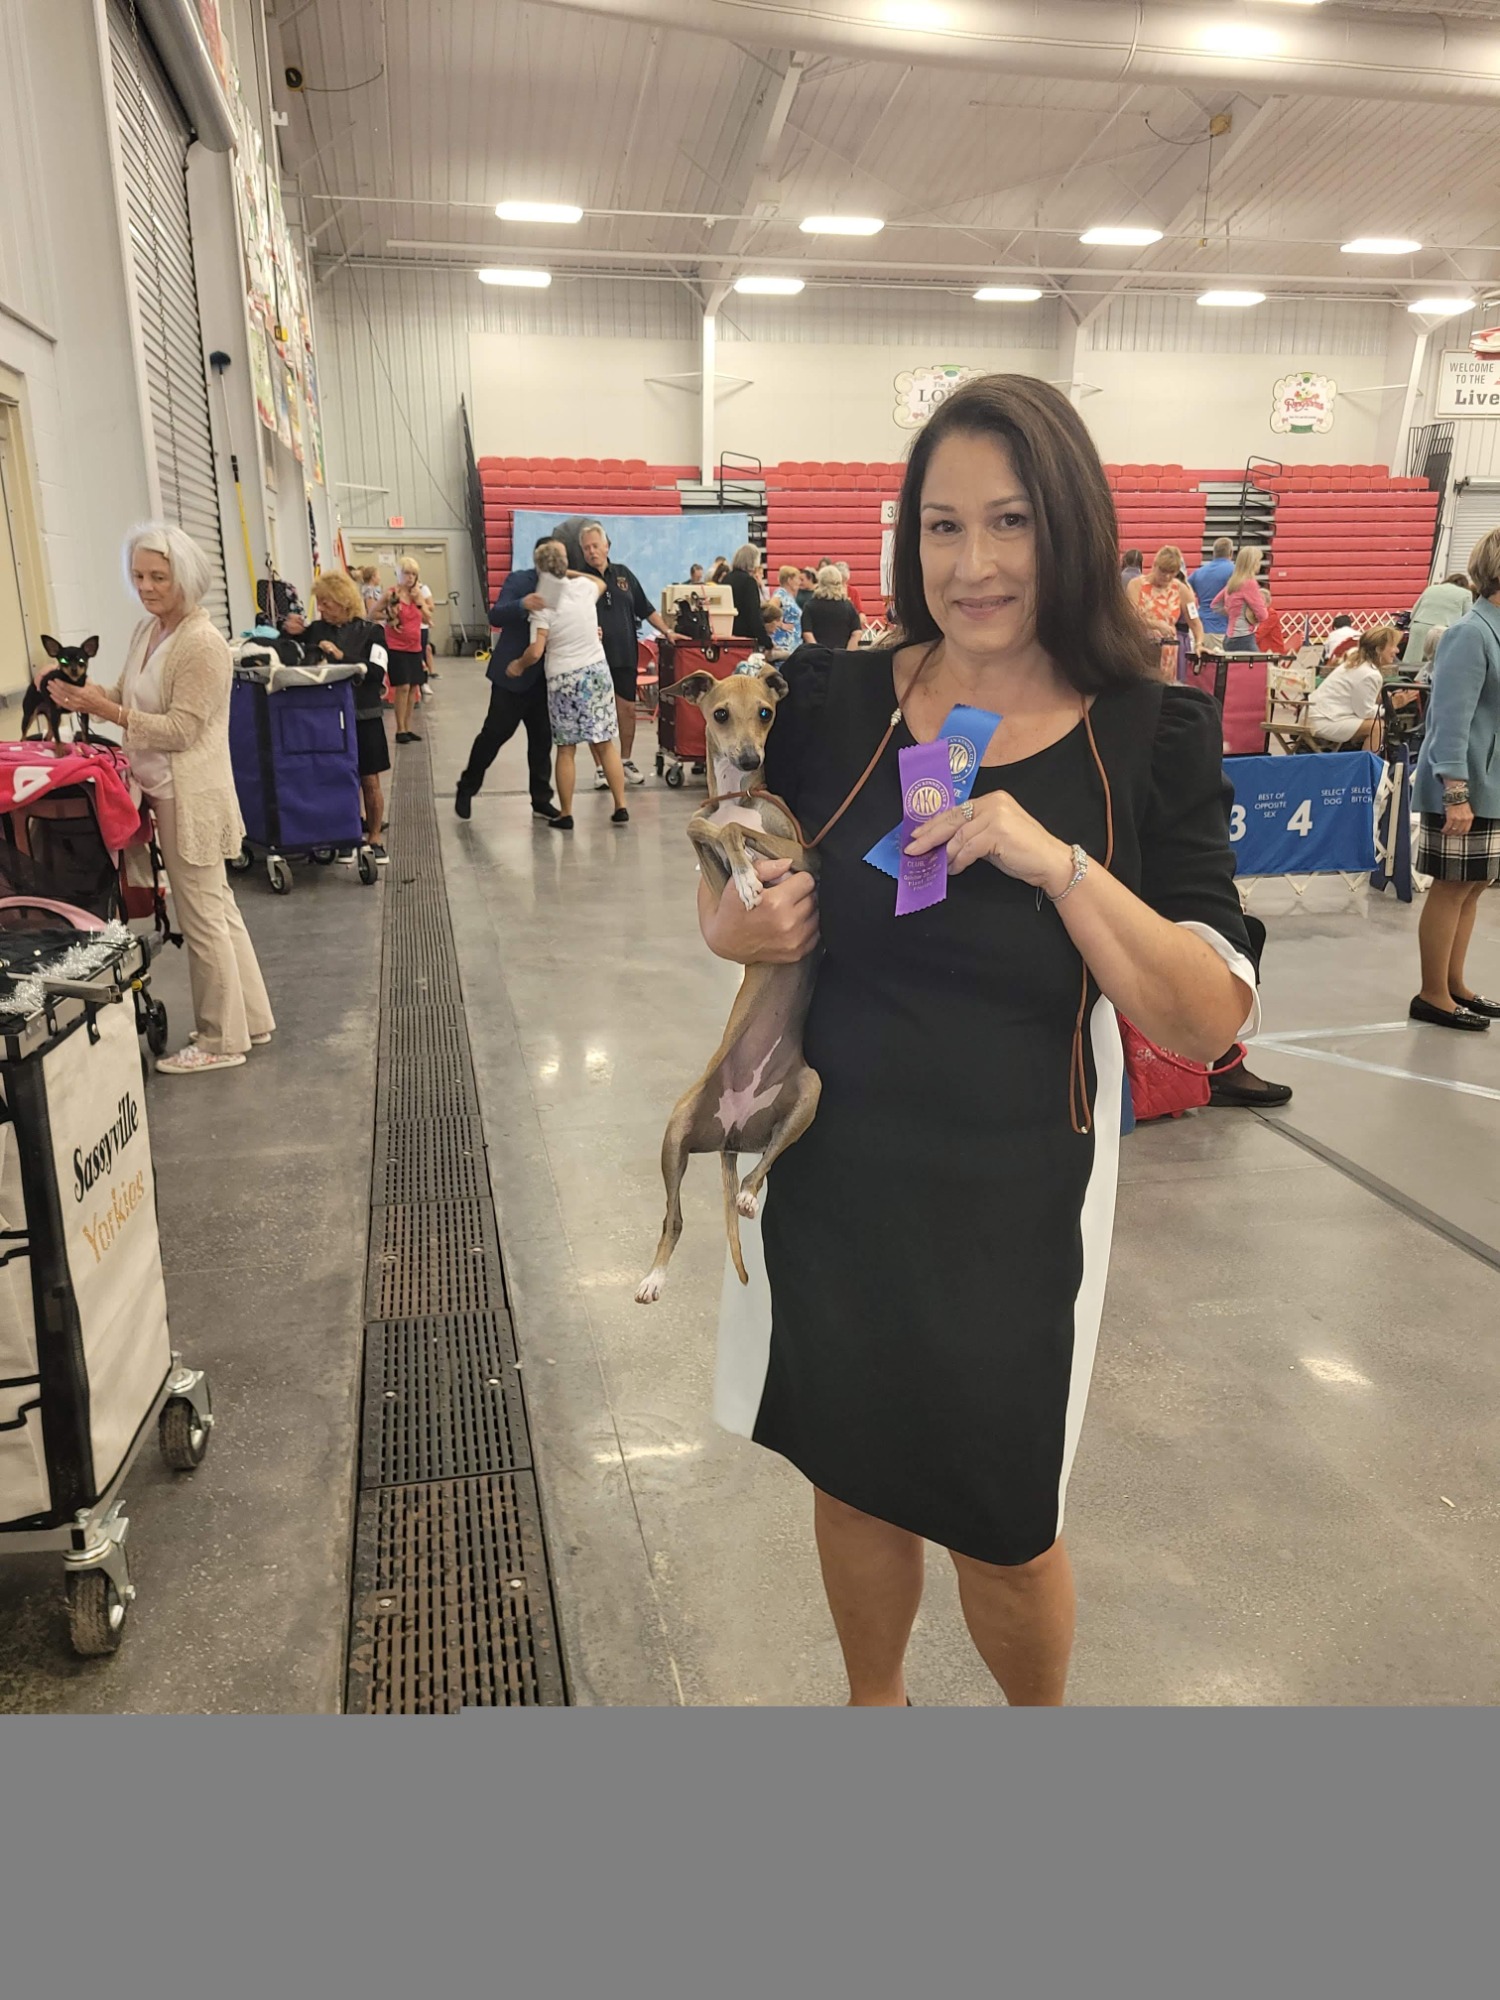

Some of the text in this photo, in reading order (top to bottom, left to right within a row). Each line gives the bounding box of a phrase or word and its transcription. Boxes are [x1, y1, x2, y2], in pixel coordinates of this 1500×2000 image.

[1449, 362, 1495, 373] WELCOME
[1455, 374, 1486, 385] TO THE
[887, 506, 894, 518] 3
[949, 744, 968, 774] KC
[1321, 788, 1346, 797] SELECT
[1351, 786, 1372, 795] SELEC
[913, 786, 942, 816] AKC
[1323, 798, 1342, 806] DOG
[1351, 795, 1373, 804] BITCH
[1254, 801, 1287, 810] OPPOSITE
[1229, 804, 1247, 842] 3
[1286, 799, 1313, 837] 4
[73, 1090, 139, 1204] Sassyville
[82, 1169, 145, 1264] Yorkies
